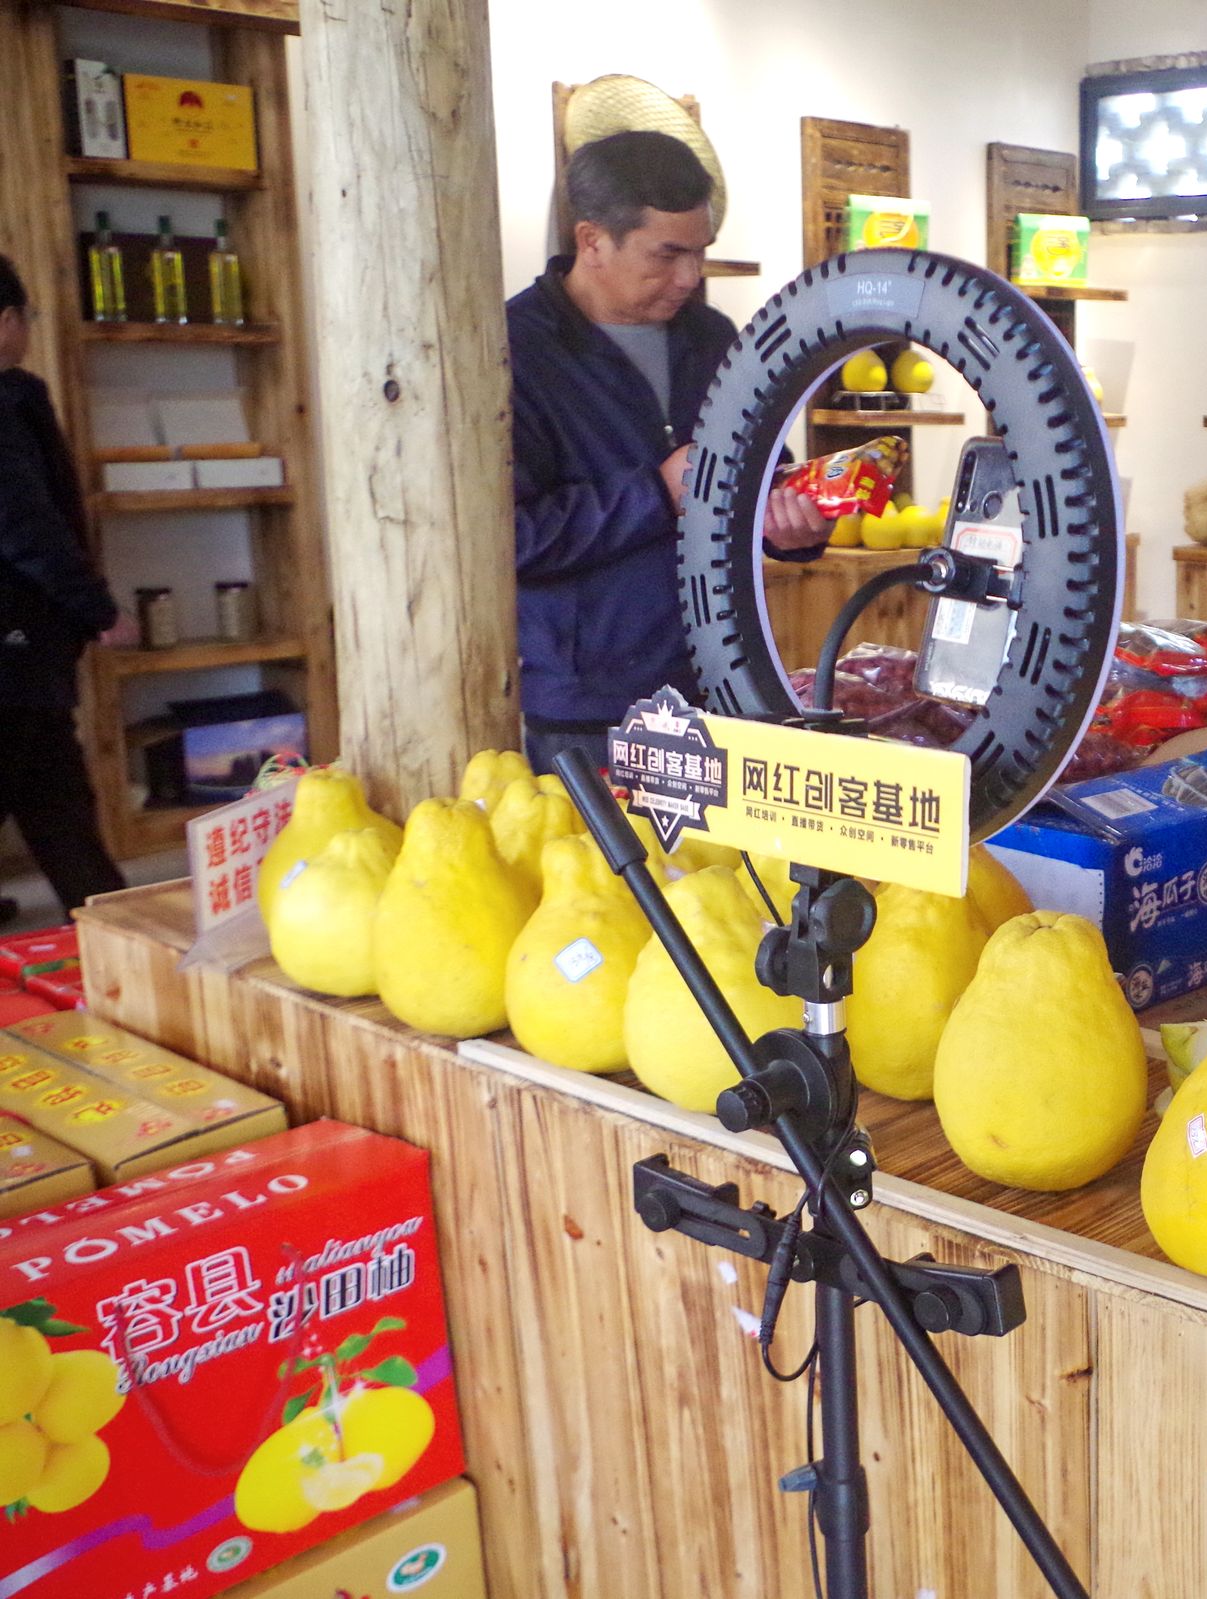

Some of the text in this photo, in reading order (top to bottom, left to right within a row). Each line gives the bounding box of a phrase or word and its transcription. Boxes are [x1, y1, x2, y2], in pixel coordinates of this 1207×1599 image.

[613, 739, 722, 785] 网红创客基地
[742, 756, 941, 833] 网红创客基地
[745, 806, 934, 855] 网红培训 直播带货 众创空间 新零售平台
[1130, 870, 1197, 933] 海瓜子
[0, 1150, 257, 1239] POMEL
[12, 1174, 309, 1283] POMELO
[96, 1246, 264, 1366] 容县
[268, 1243, 416, 1344] 沙田柚
